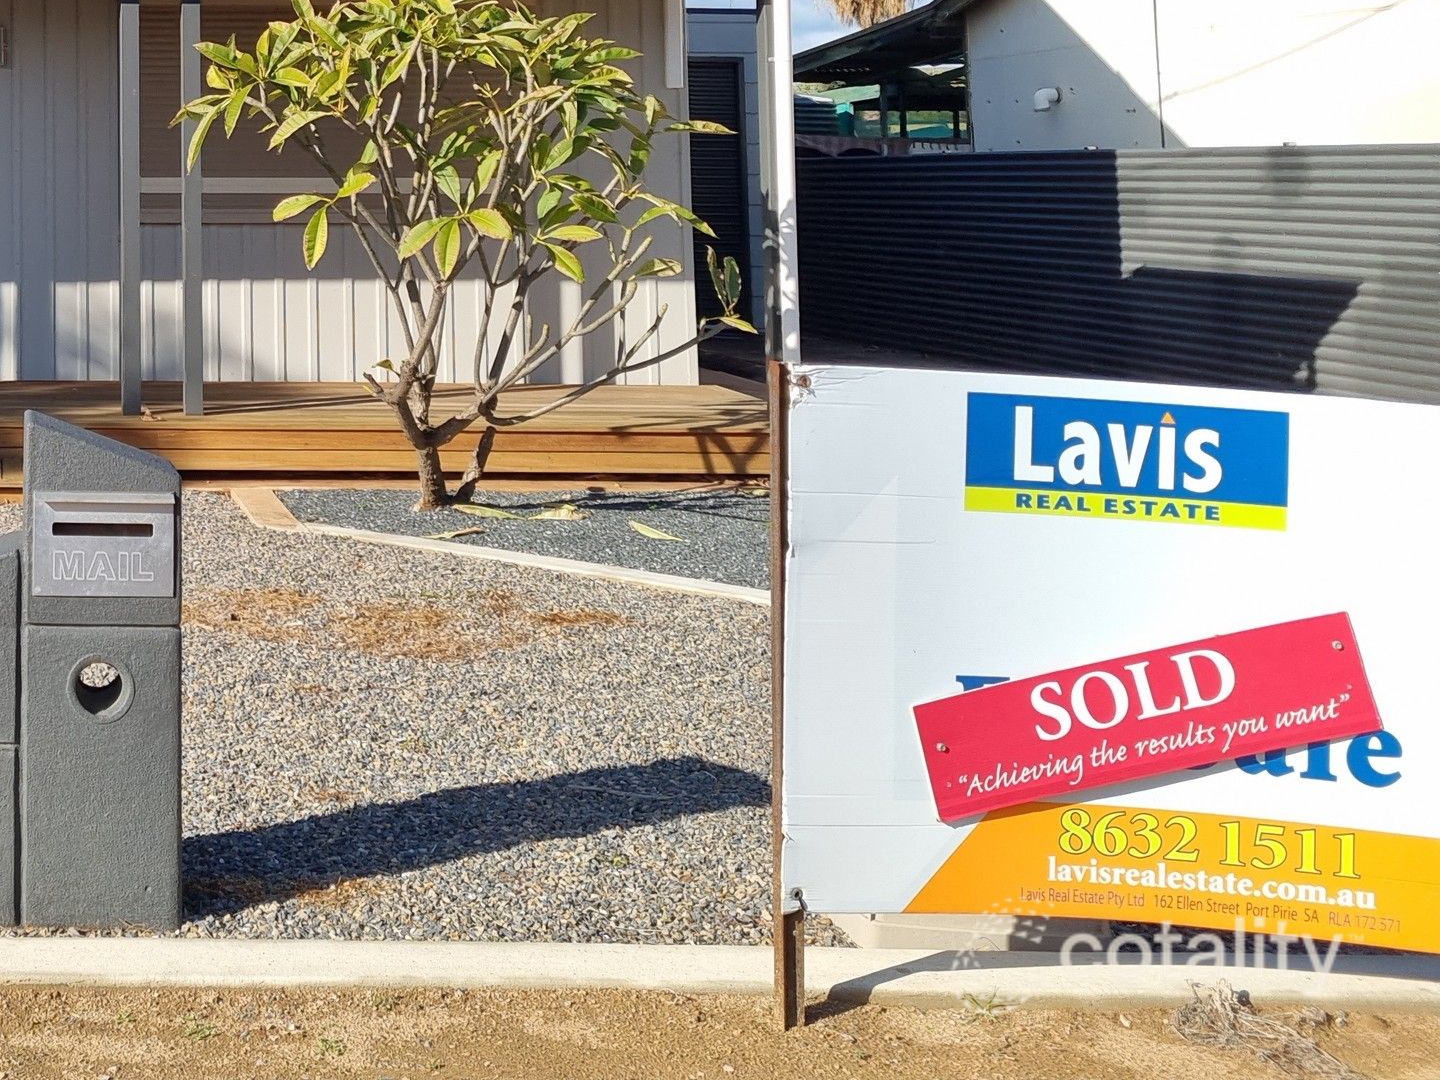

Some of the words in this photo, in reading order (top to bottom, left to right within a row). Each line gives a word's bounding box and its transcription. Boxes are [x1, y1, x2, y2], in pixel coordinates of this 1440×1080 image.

[1013, 405, 1223, 493] Lavis
[1015, 493, 1091, 512] REAL
[1104, 498, 1220, 521] ESTATE
[52, 550, 154, 582] MAIL
[1030, 649, 1236, 741] SOLD
[1090, 739, 1127, 767] the
[1135, 722, 1215, 757] results
[1221, 714, 1268, 753] you
[1058, 808, 1200, 862] 8632
[1219, 821, 1361, 879] 1511
[1020, 887, 1046, 902] Lavis
[1048, 887, 1070, 903] Real
[1073, 889, 1105, 905] Estate
[1107, 891, 1125, 908] Pty
[1128, 893, 1145, 907] Ltd
[1154, 894, 1174, 909] 162
[1177, 895, 1203, 911] Ellen
[1206, 898, 1240, 916] Street
[1246, 901, 1269, 918] Port
[1273, 904, 1298, 921] Pirie
[1304, 908, 1320, 924] SA
[1328, 911, 1351, 928] RLA
[1048, 856, 1377, 910] lavisrealestate.com.au
